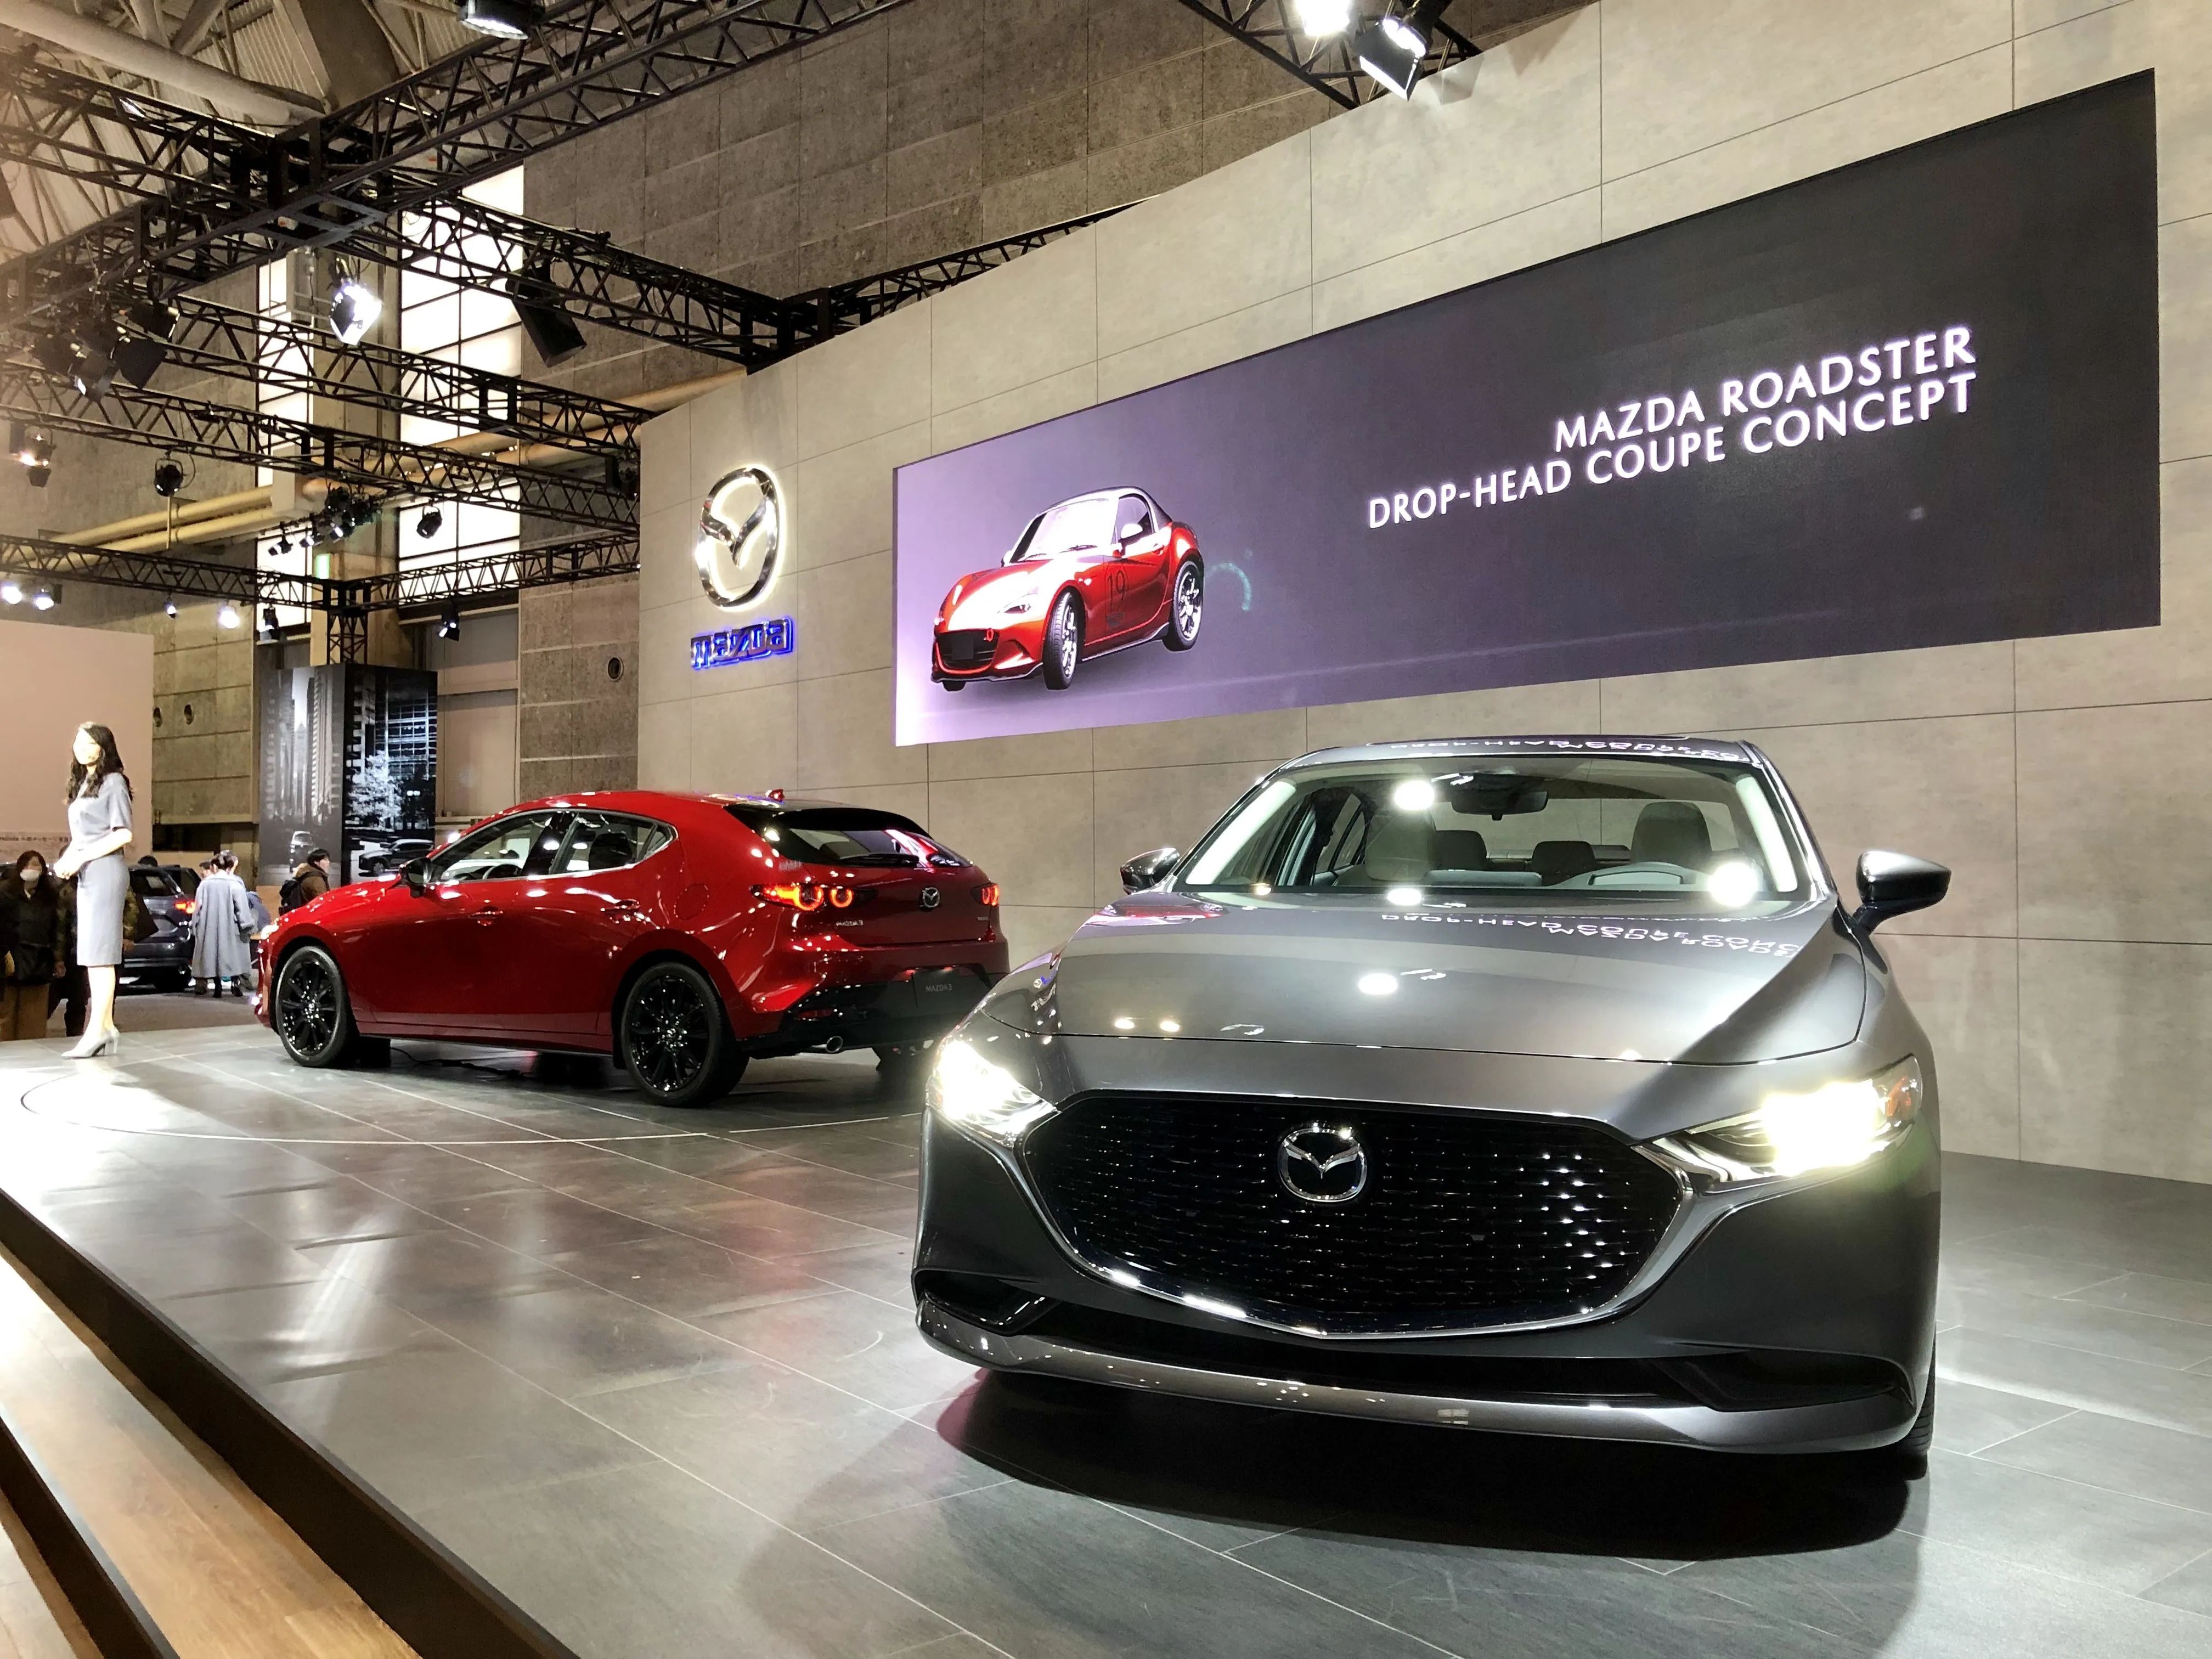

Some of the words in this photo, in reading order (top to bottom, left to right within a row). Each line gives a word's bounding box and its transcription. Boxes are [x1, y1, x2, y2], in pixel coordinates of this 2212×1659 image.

[1369, 459, 1572, 529] DROP-HEAD
[1587, 425, 1726, 484] COUPE
[1741, 371, 1977, 454] CONCEPT
[1555, 391, 1706, 453] MAZDA
[1722, 326, 1977, 415] ROADSTER
